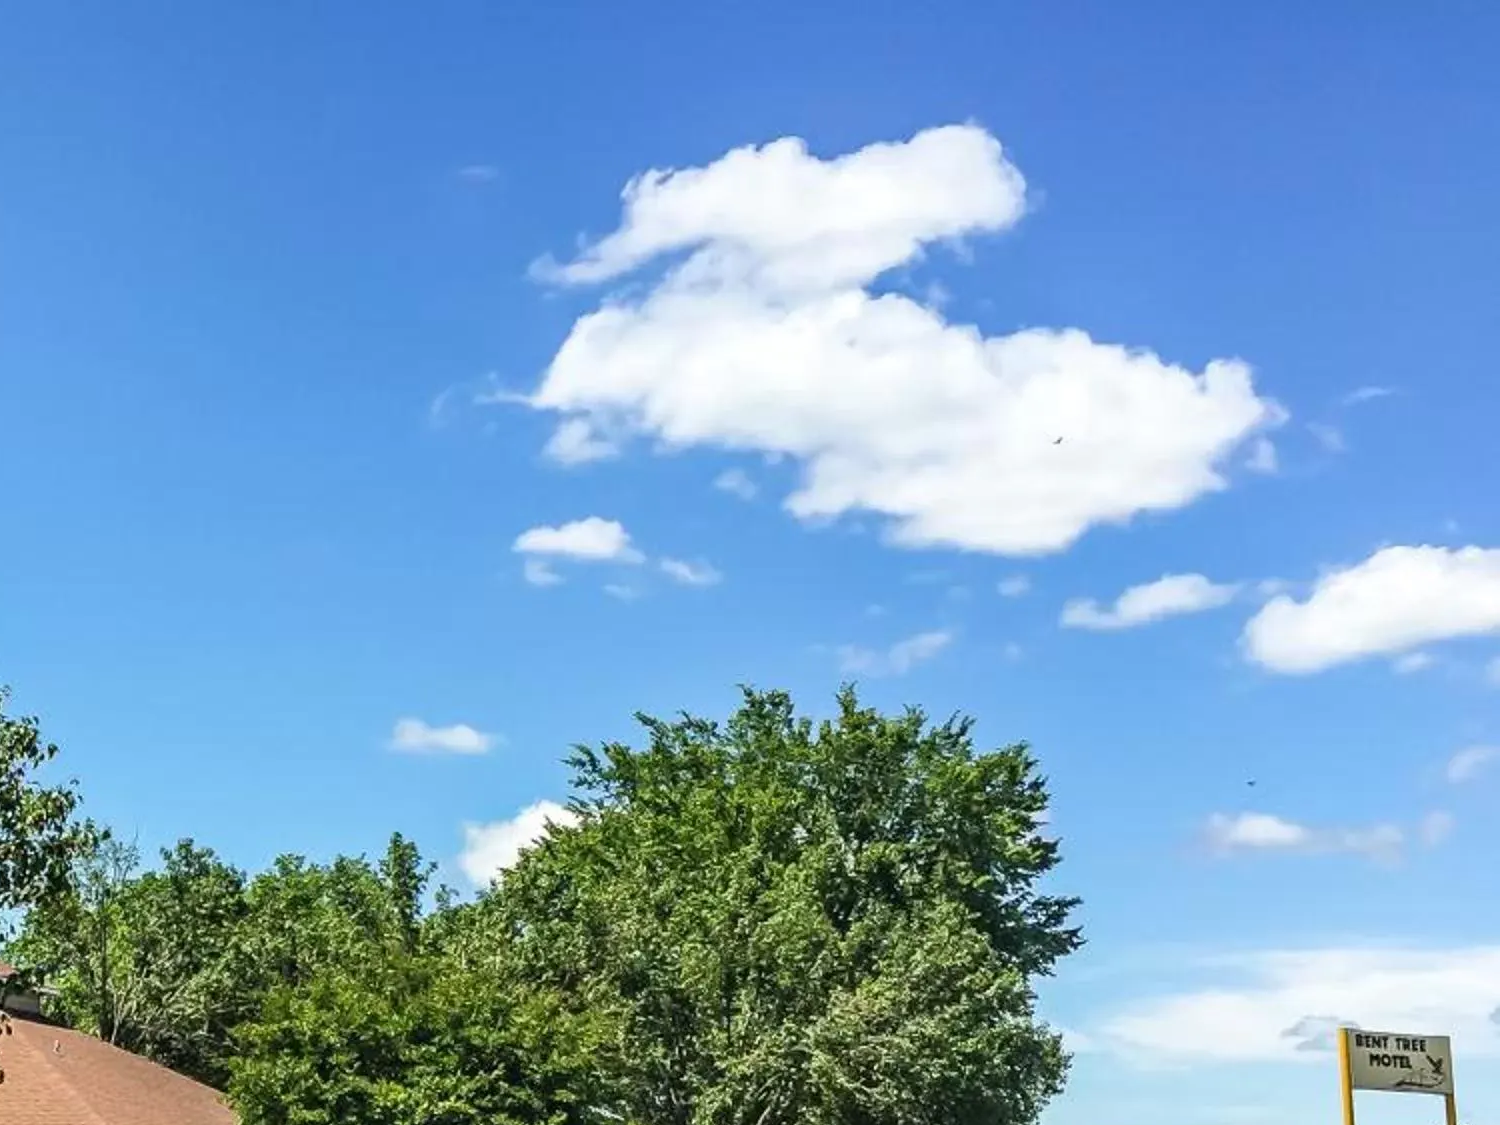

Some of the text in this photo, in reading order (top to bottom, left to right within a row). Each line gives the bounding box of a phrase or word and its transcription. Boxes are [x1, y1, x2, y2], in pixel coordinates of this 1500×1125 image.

[1355, 1034, 1426, 1052] BENT TREE
[1369, 1053, 1412, 1069] MOTEL
